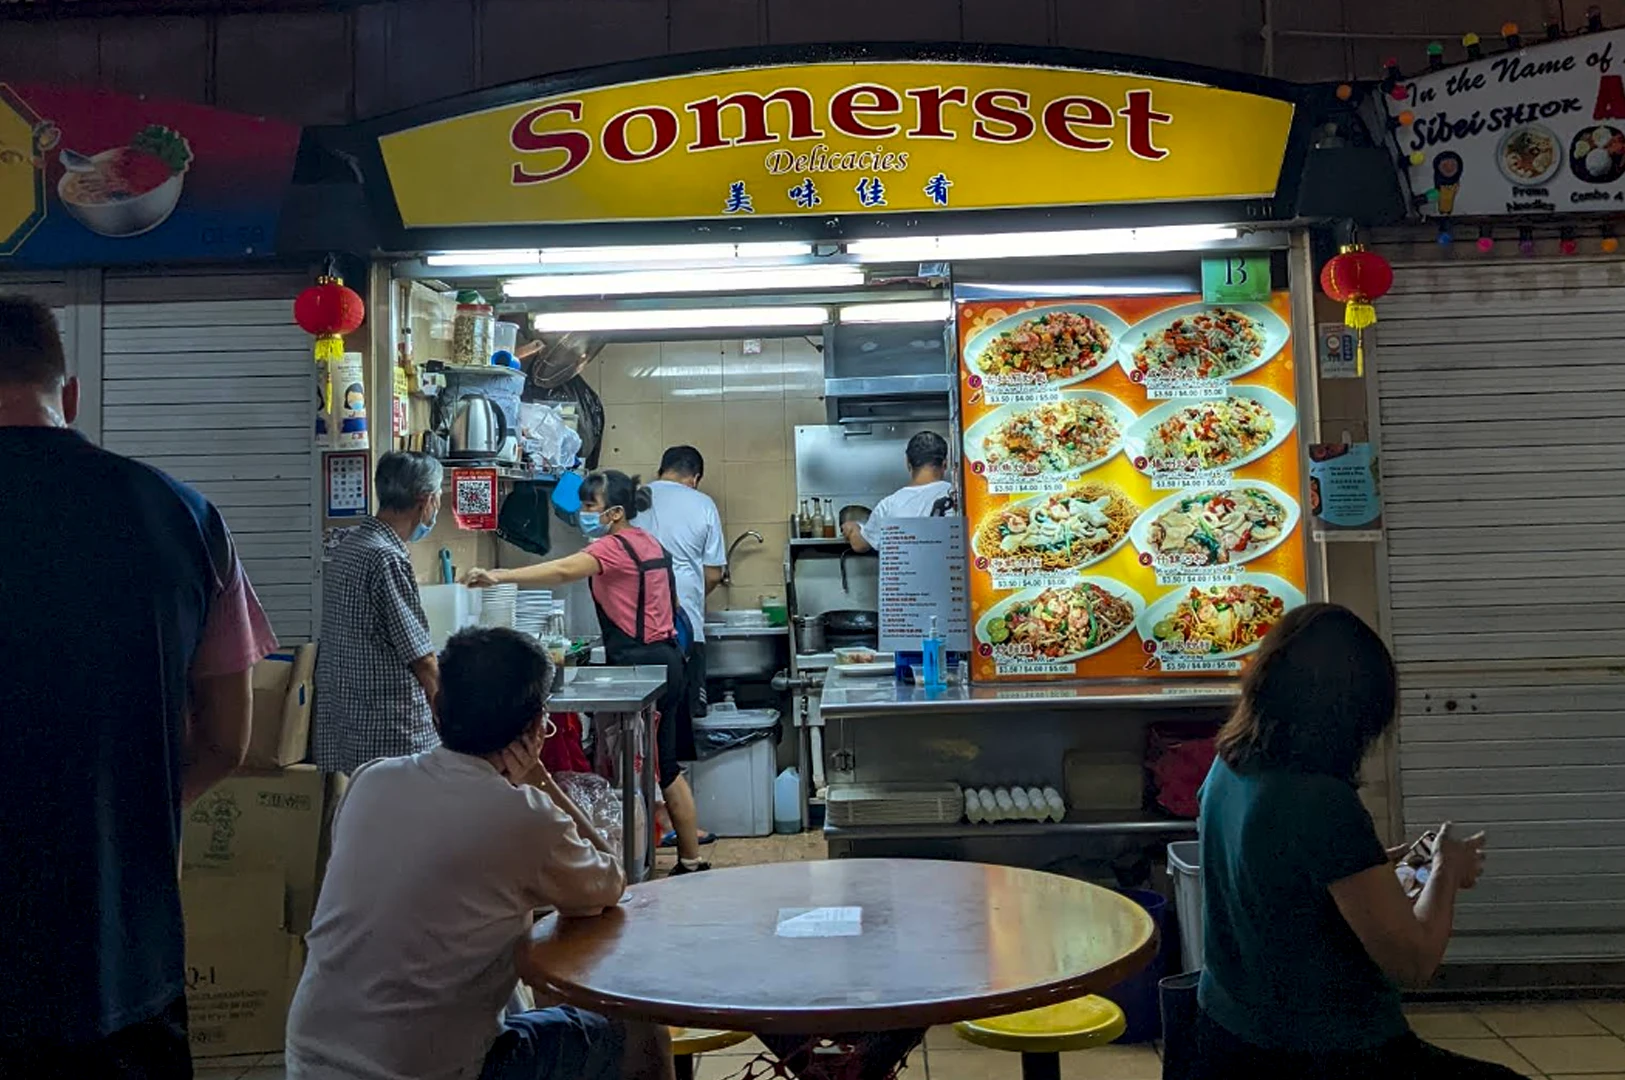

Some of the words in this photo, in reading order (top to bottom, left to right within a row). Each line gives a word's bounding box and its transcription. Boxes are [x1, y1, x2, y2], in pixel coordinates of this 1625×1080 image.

[1405, 83, 1437, 107] In
[1446, 67, 1486, 96] the
[1491, 56, 1576, 83] Name
[1586, 42, 1614, 74] of
[510, 83, 1173, 185] Somerset
[1410, 111, 1486, 151] Sibei
[1487, 98, 1582, 132] SHIOK
[766, 145, 908, 173] Delicacies
[722, 173, 953, 213] 美味佳肴
[1571, 189, 1610, 203] Combo
[1226, 256, 1248, 285] B
